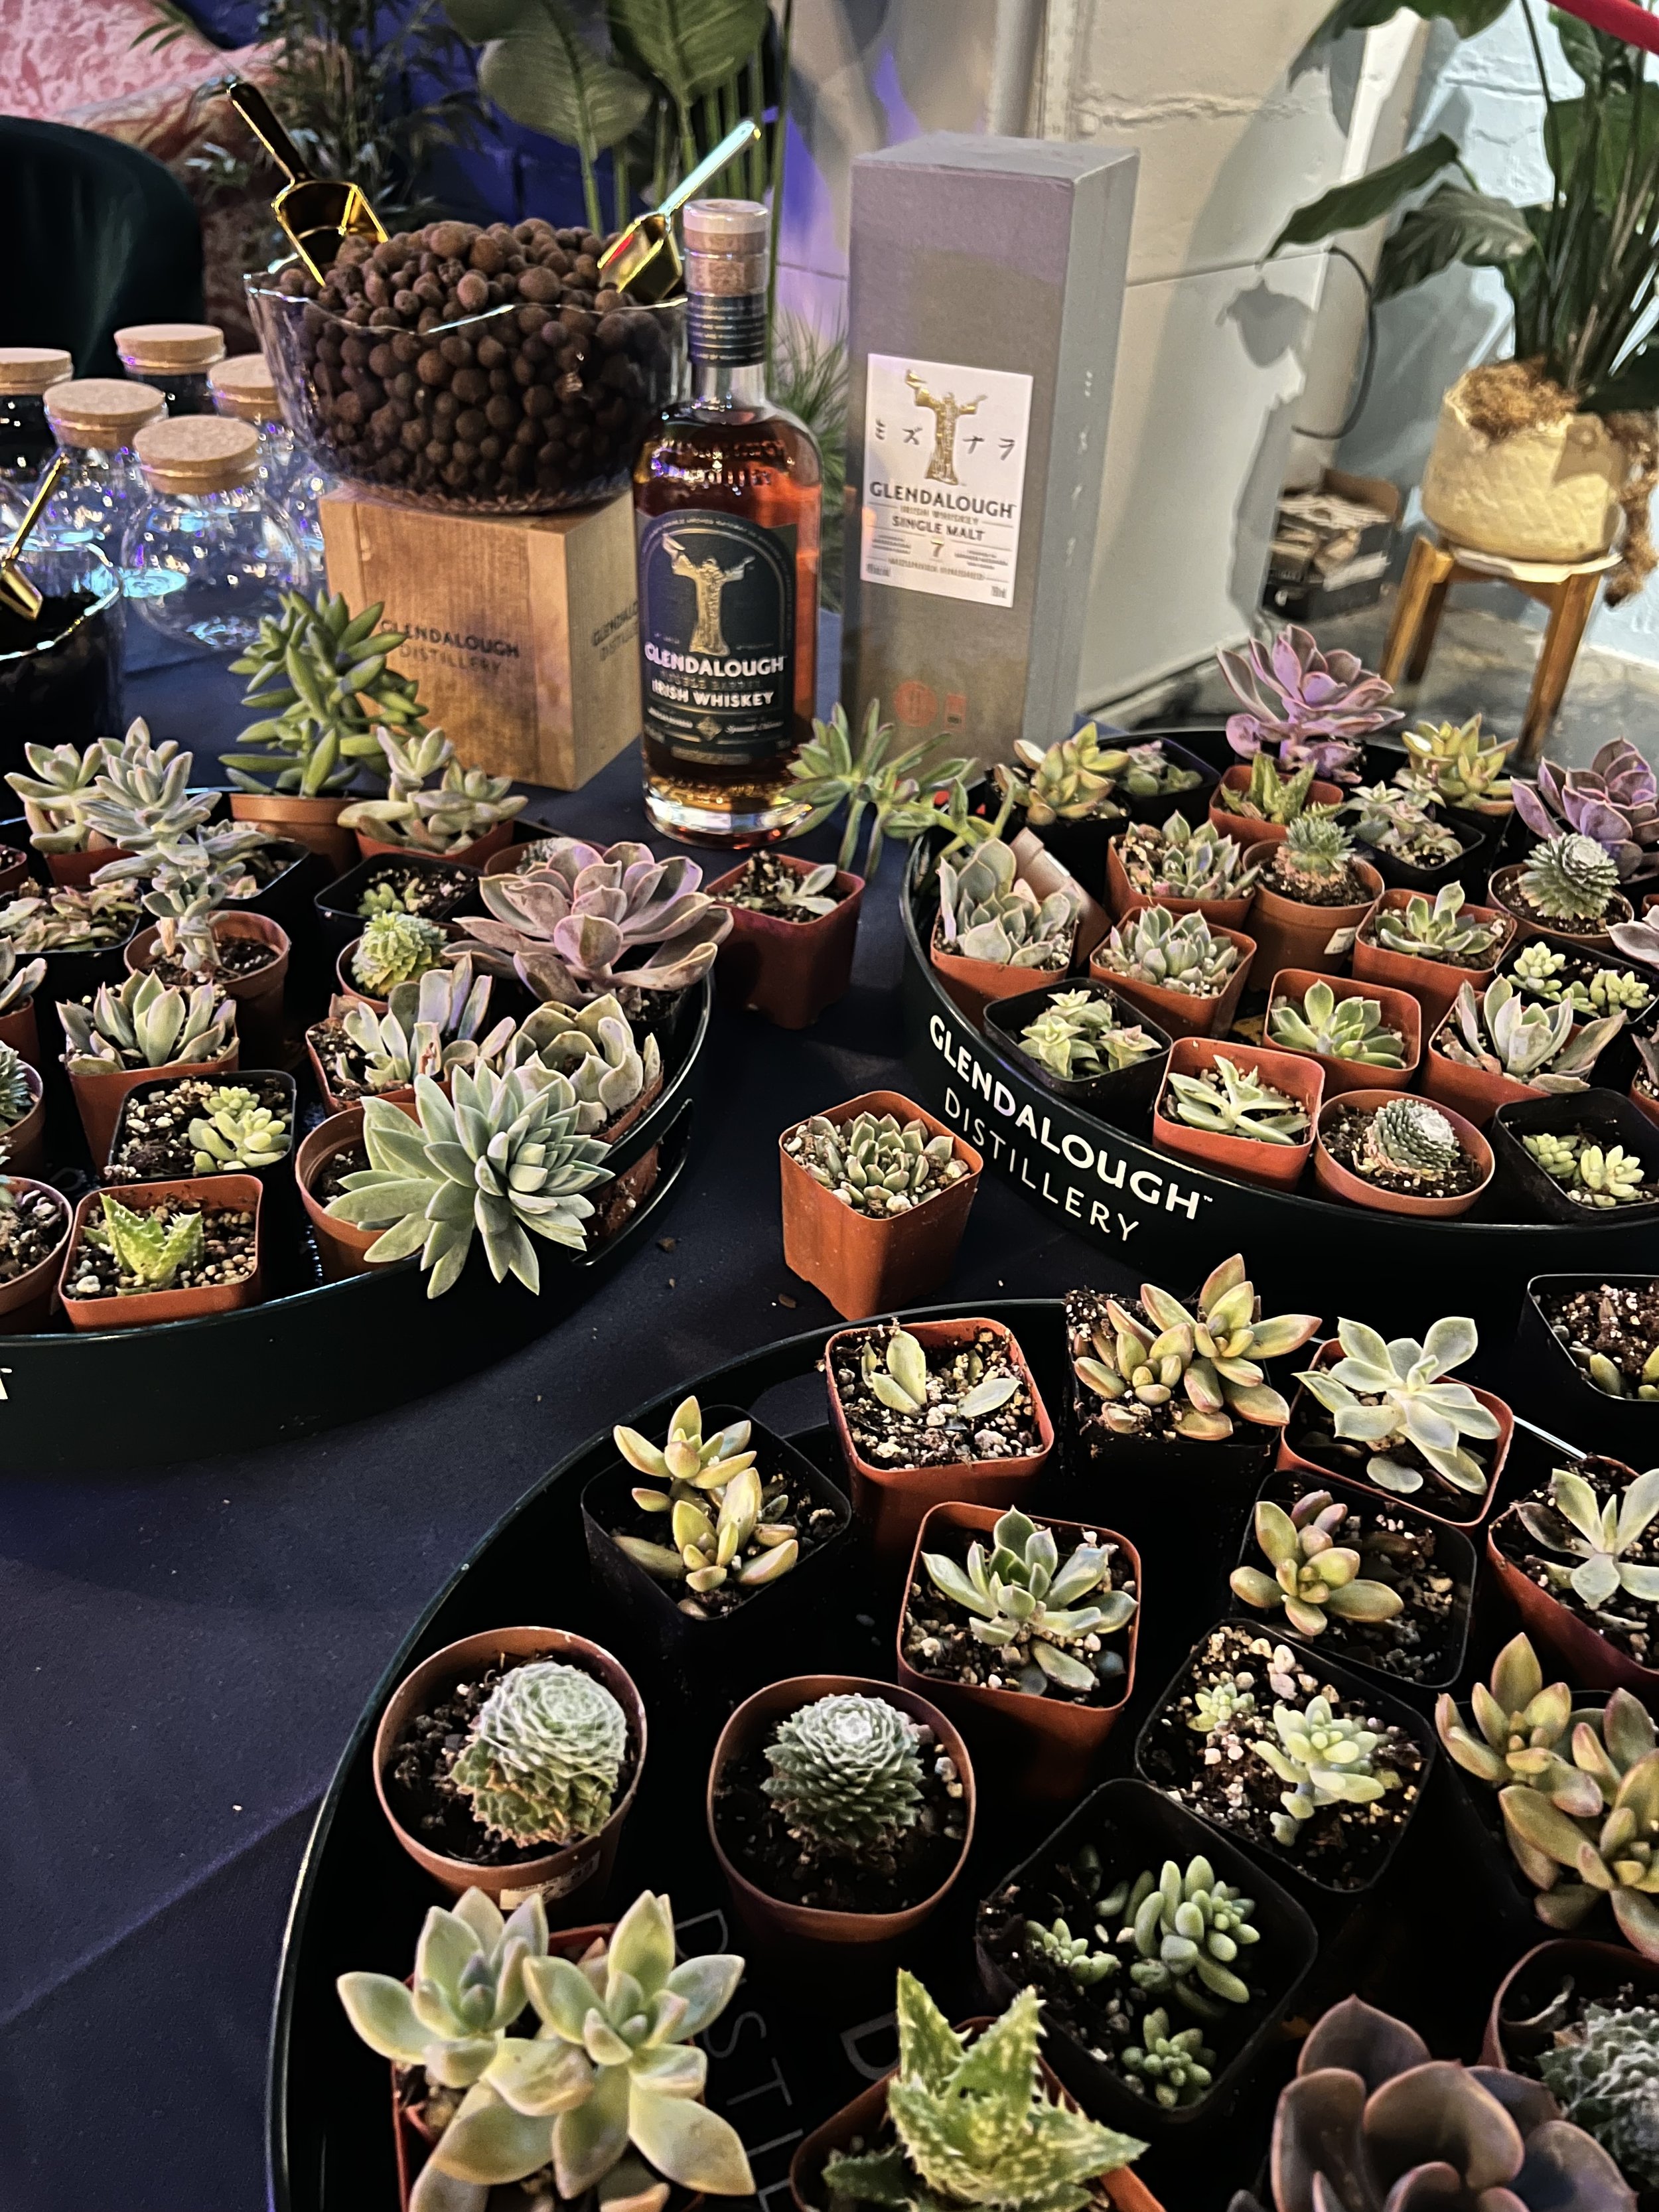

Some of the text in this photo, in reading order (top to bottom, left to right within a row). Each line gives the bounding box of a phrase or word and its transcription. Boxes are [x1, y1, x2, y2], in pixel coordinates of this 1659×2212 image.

[869, 480, 1013, 519] GLENDALOUGH
[892, 515, 985, 542] SINGLE MALT
[930, 538, 944, 558] 7
[644, 641, 784, 678] GLENDALOUGH
[652, 679, 774, 707] IRISH WHISKEY
[929, 1015, 1200, 1220] GLENDALOUGH
[944, 1087, 1139, 1242] DISTILLERY
